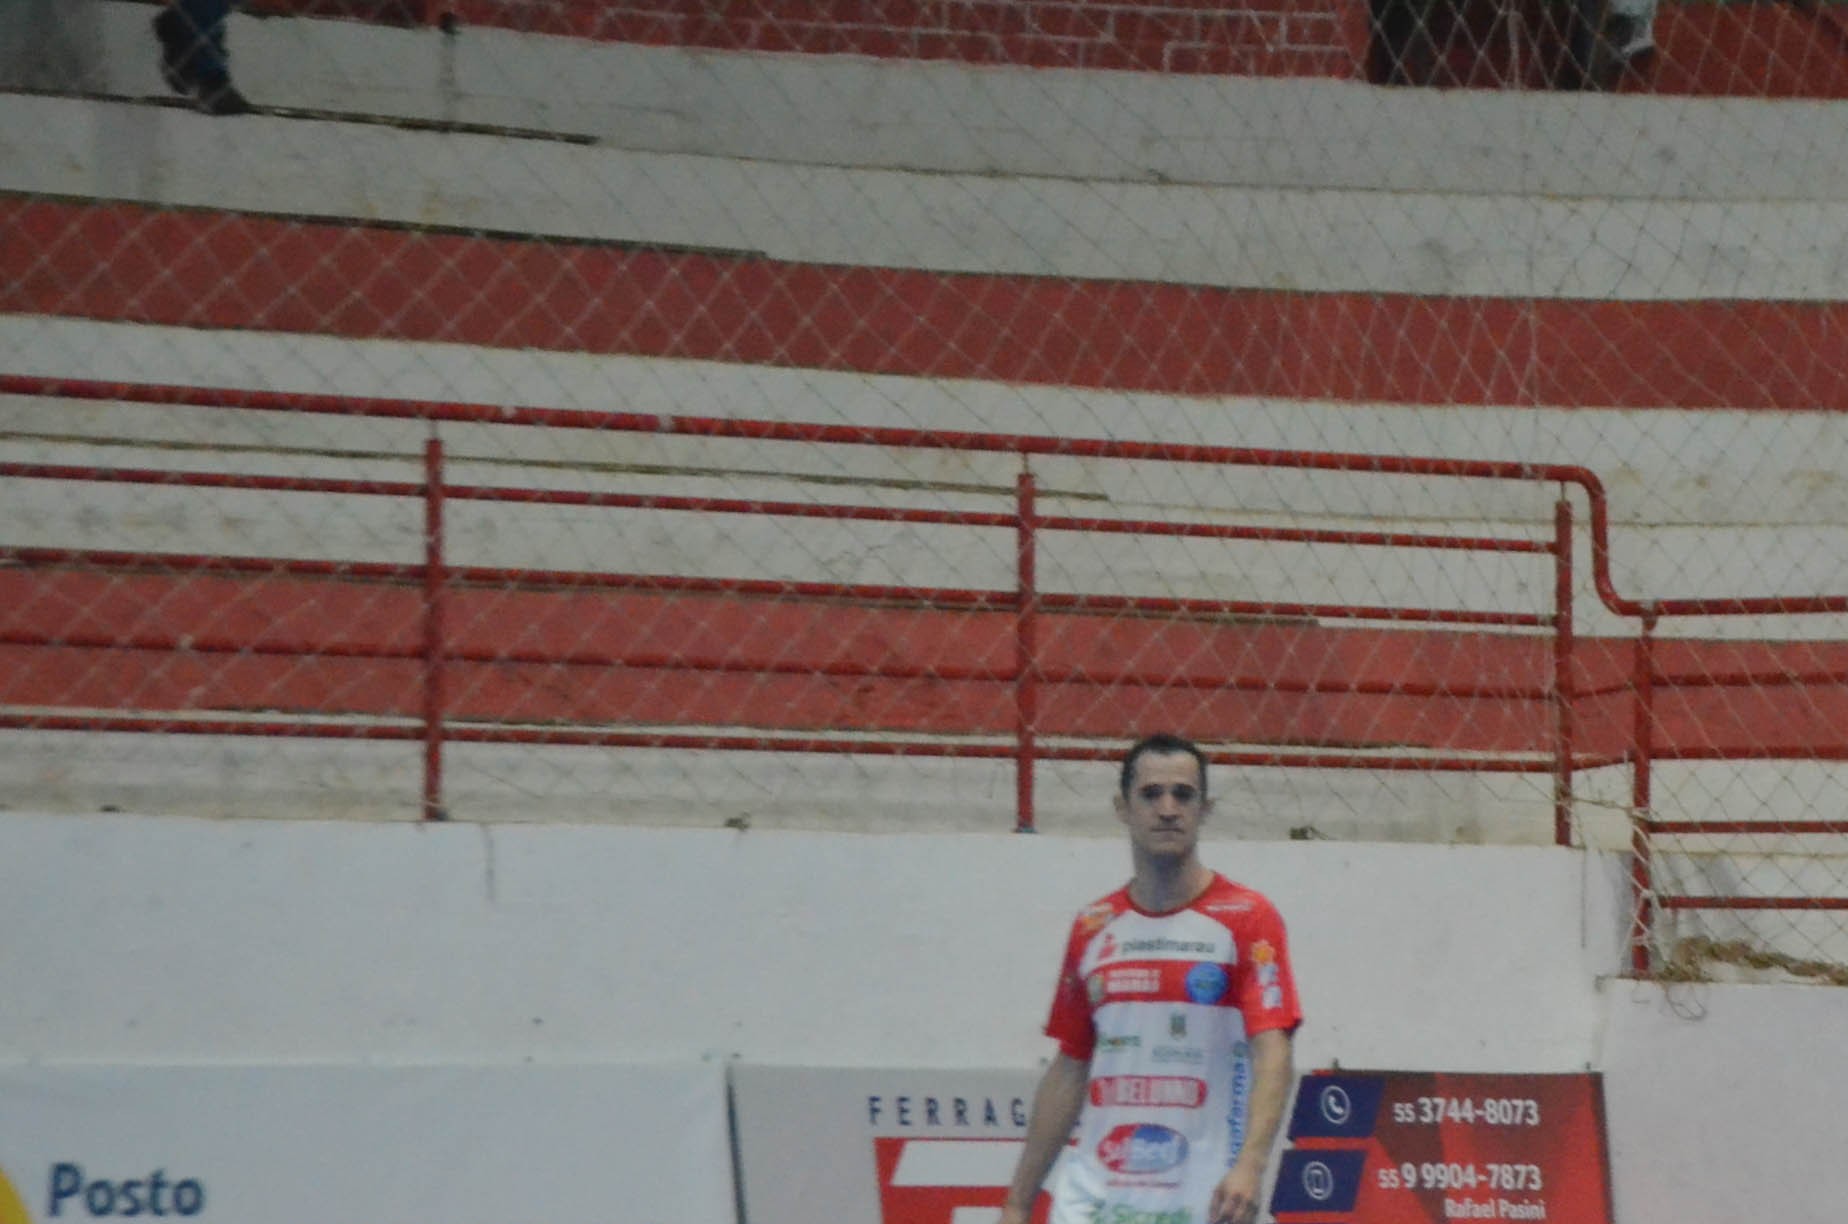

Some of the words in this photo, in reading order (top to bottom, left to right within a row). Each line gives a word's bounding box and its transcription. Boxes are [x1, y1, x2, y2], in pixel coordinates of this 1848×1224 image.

[868, 1095, 1028, 1127] FERRAG
[1394, 1102, 1415, 1123] 55
[1417, 1096, 1541, 1126] 3744-8073
[48, 1162, 205, 1218] Posto
[1378, 1168, 1400, 1190] 55
[1401, 1162, 1417, 1189] 9
[1420, 1163, 1542, 1191] 9904-7873
[1445, 1197, 1496, 1219] Rafael
[1499, 1198, 1547, 1220] Pasini
